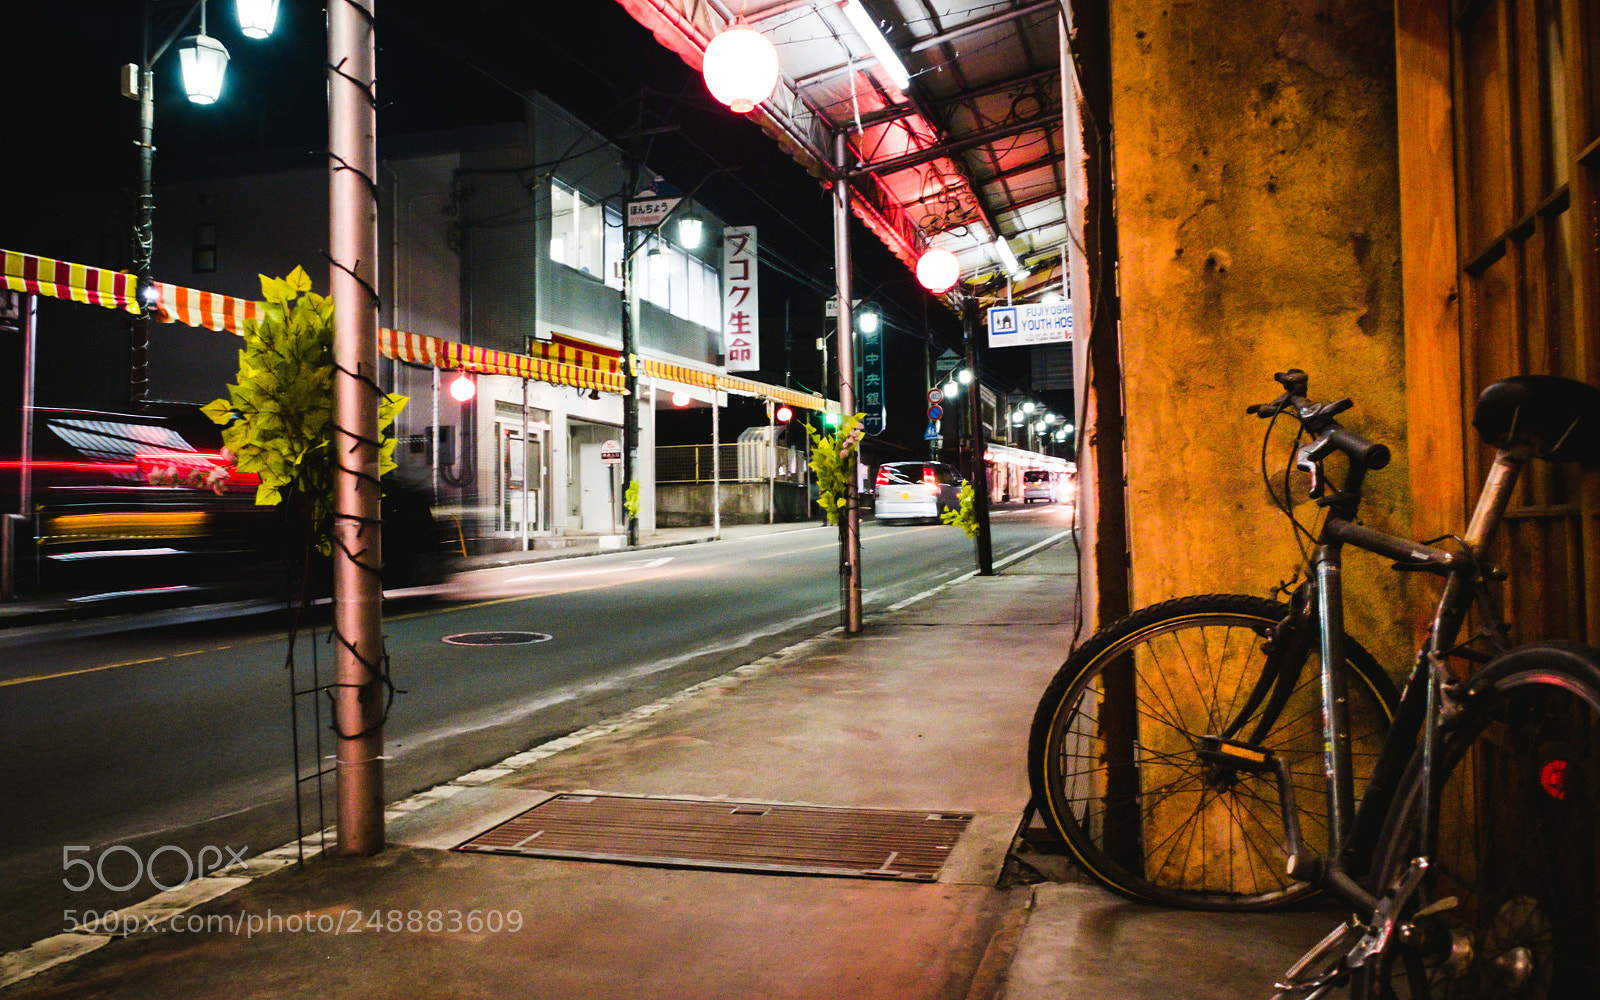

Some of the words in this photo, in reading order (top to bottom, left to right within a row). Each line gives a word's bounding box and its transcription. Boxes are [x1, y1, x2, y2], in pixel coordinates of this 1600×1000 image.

[630, 202, 668, 215] ほんちょう
[726, 233, 752, 362] フコク生命
[1021, 317, 1052, 332] YOUTH
